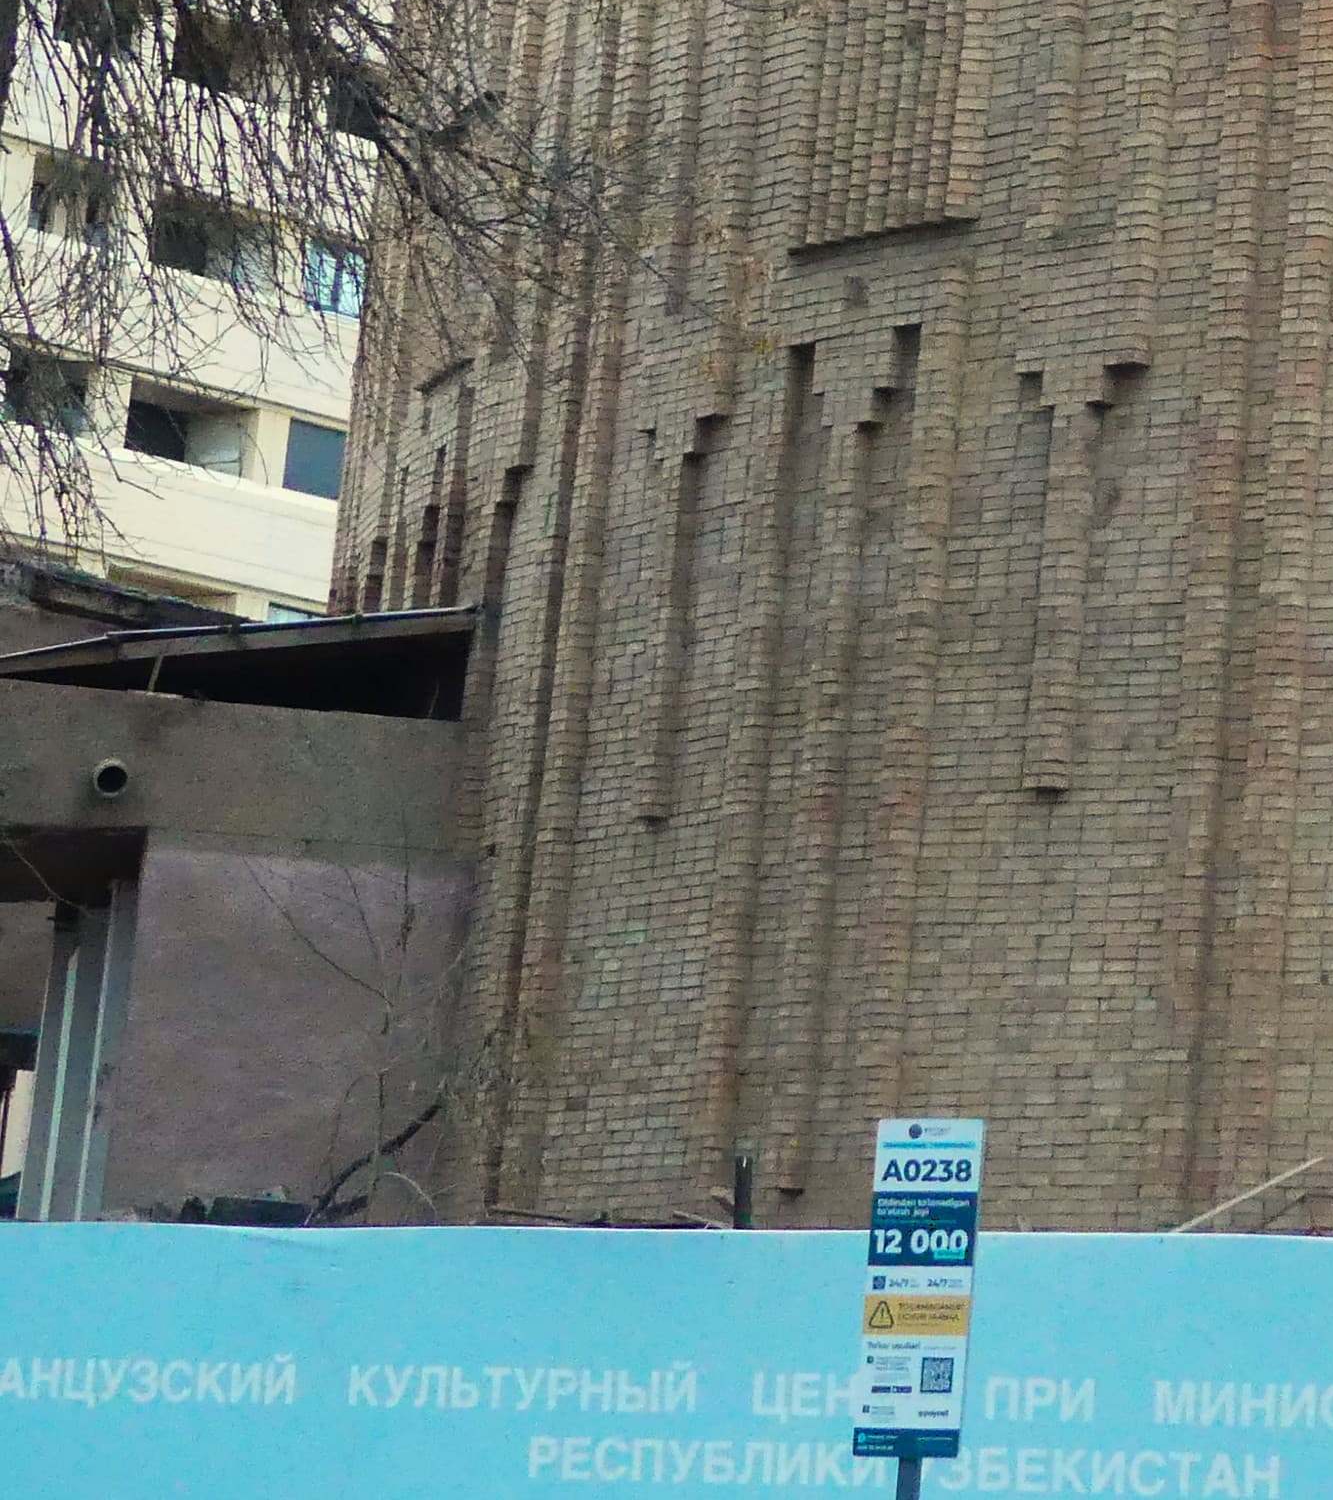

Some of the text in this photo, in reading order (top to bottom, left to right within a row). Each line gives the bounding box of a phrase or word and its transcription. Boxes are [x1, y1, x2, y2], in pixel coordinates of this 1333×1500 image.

[881, 1158, 972, 1182] A0238
[874, 1228, 969, 1254] 12 000
[348, 1360, 698, 1412] КУЛЬТУРНЫЙ
[752, 1371, 858, 1423] ЦЕН
[984, 1375, 1096, 1422] ПРИ
[527, 1435, 1281, 1498] РЕСПУБЛИКИ ЗБЕКИСТАН
